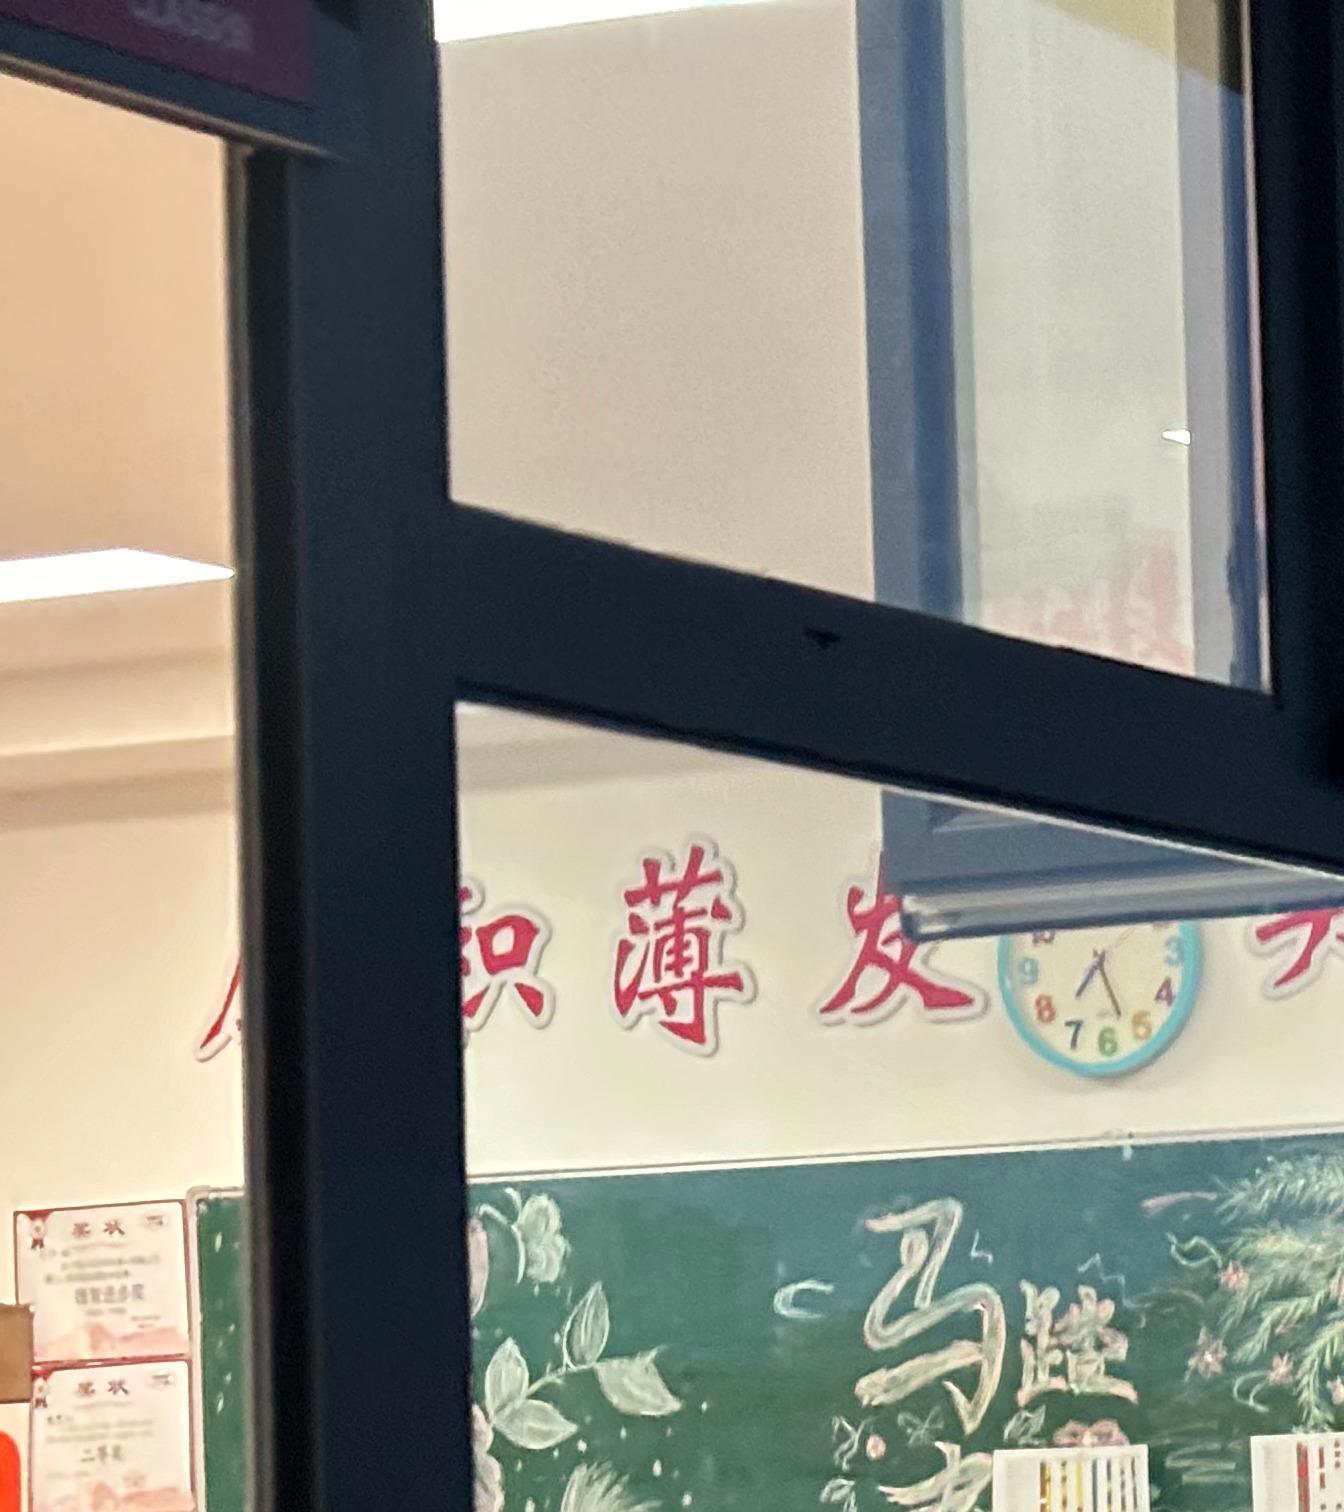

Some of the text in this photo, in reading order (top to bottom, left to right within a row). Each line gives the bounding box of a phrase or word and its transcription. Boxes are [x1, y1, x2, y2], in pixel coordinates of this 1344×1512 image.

[200, 842, 973, 1053] 积薄发
[1155, 976, 1175, 1006] 4
[1035, 994, 1056, 1024] 8
[1065, 1019, 1084, 1050] 7
[1097, 1027, 1118, 1057] 6
